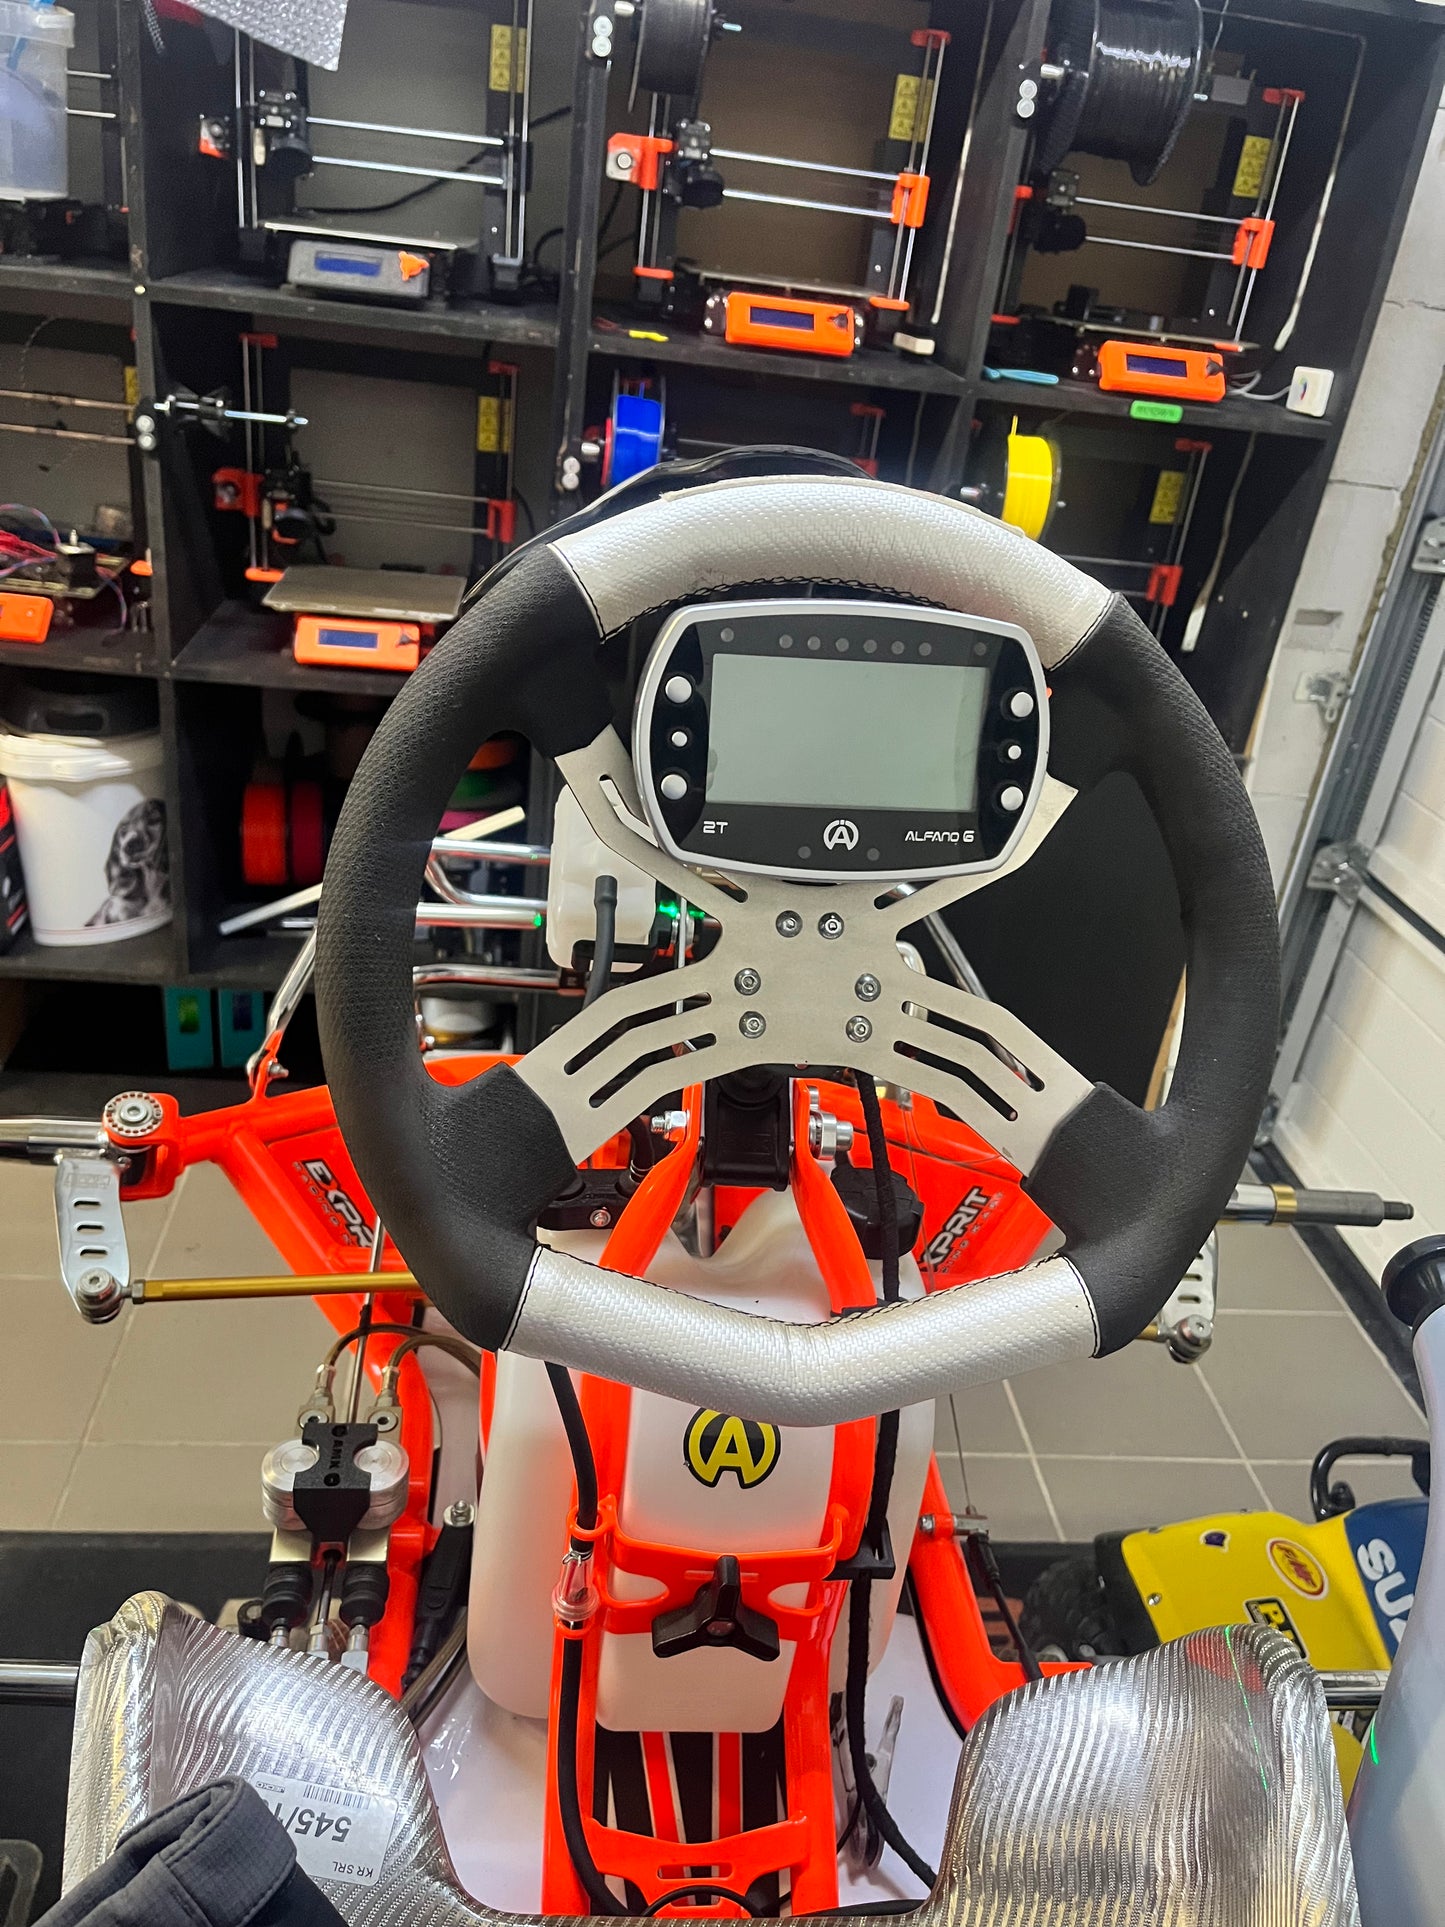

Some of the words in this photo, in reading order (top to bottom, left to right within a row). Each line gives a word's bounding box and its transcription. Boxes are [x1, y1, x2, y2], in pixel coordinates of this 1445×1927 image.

[703, 820, 729, 835] 2T
[904, 830, 960, 843] ALFANO
[962, 830, 975, 843] 6
[300, 1158, 376, 1248] EXPR
[918, 1185, 990, 1270] XPRIT
[263, 1798, 352, 1843] 545/1
[332, 1861, 355, 1874] SRL
[356, 1866, 374, 1878] KR
